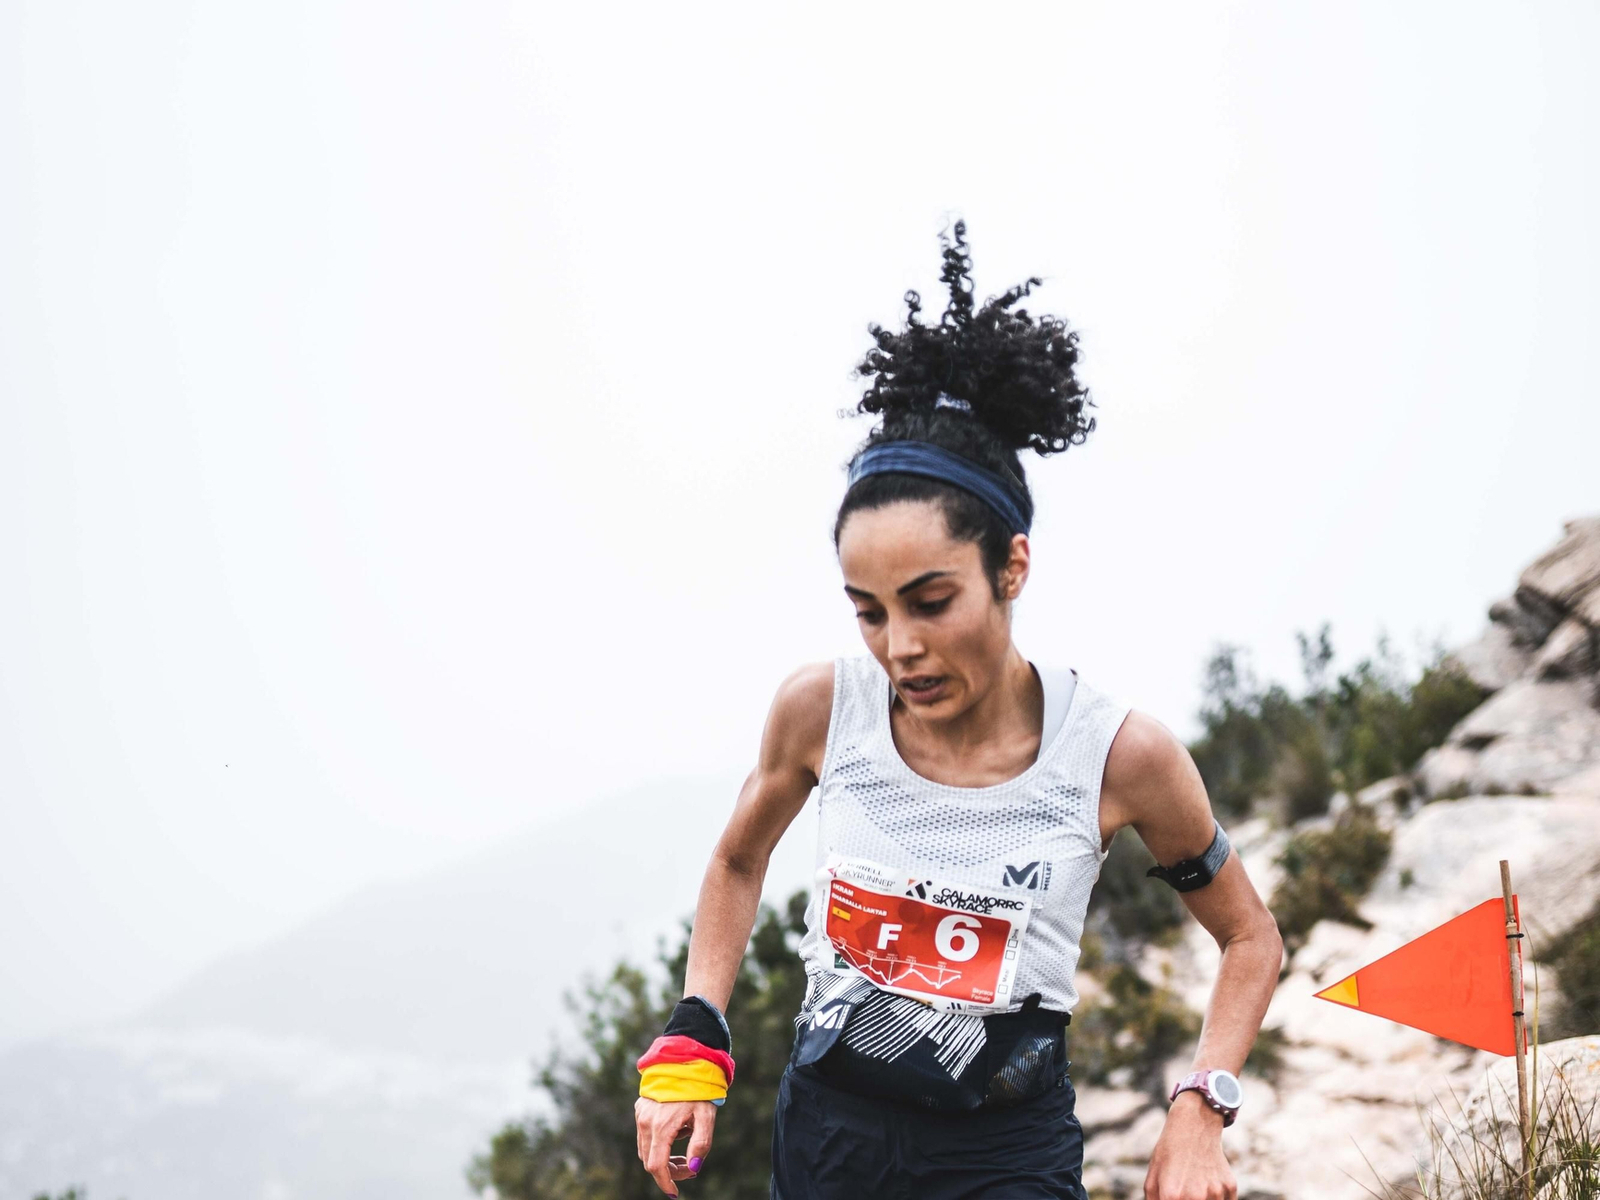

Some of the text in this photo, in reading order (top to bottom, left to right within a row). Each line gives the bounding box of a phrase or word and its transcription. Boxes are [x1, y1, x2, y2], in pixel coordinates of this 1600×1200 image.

[841, 868, 894, 888] SKYRUNNER
[1043, 862, 1053, 891] MILLET
[832, 883, 854, 897] IKRAM
[941, 888, 1025, 911] CALAMORRC
[932, 894, 993, 915] SKYRACE
[877, 923, 903, 950] F
[935, 914, 983, 962] 6
[971, 993, 991, 1002] Female
